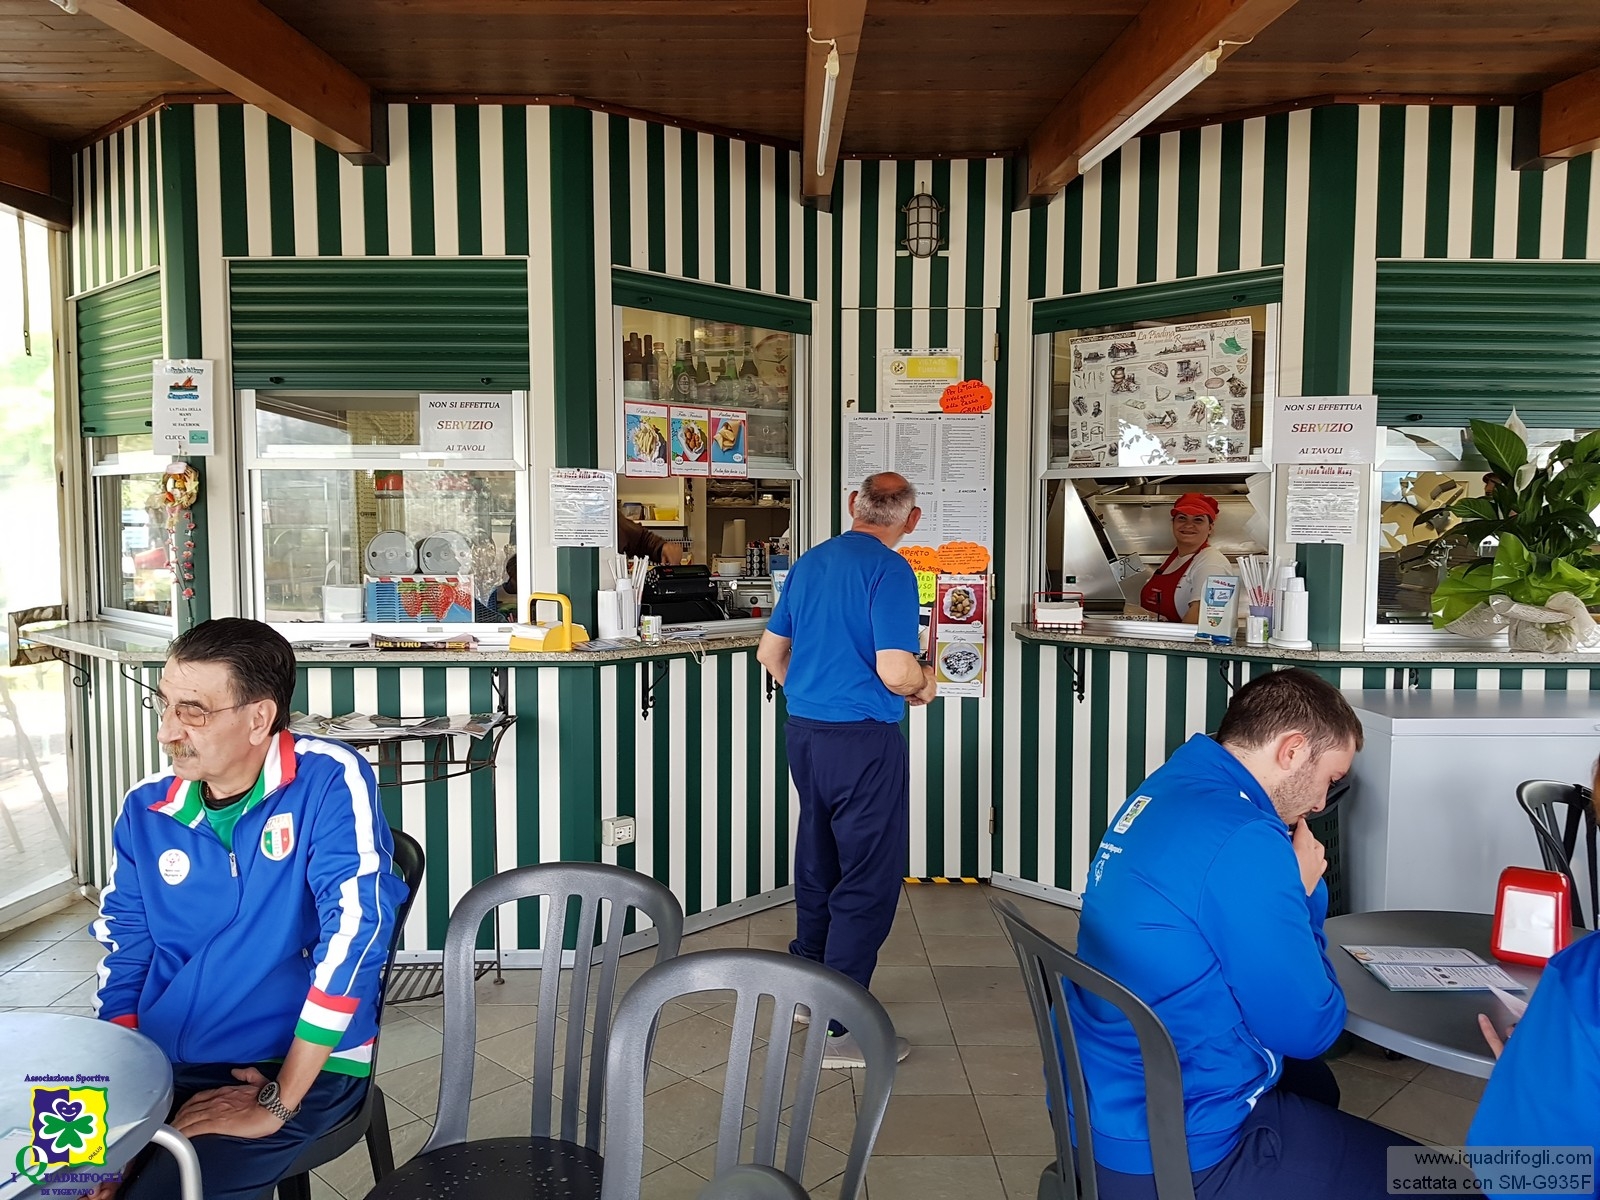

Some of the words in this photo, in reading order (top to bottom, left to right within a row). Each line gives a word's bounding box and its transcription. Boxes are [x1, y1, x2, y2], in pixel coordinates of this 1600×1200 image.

[1149, 327, 1175, 340] Piadina
[459, 401, 501, 409] EFFETTUA
[437, 420, 494, 430] SERVIZIO
[1291, 423, 1354, 433] SERVIZIO
[457, 444, 486, 452] TAVOLI
[1305, 467, 1319, 476] piada
[1321, 466, 1335, 475] della
[899, 549, 930, 557] APERTO
